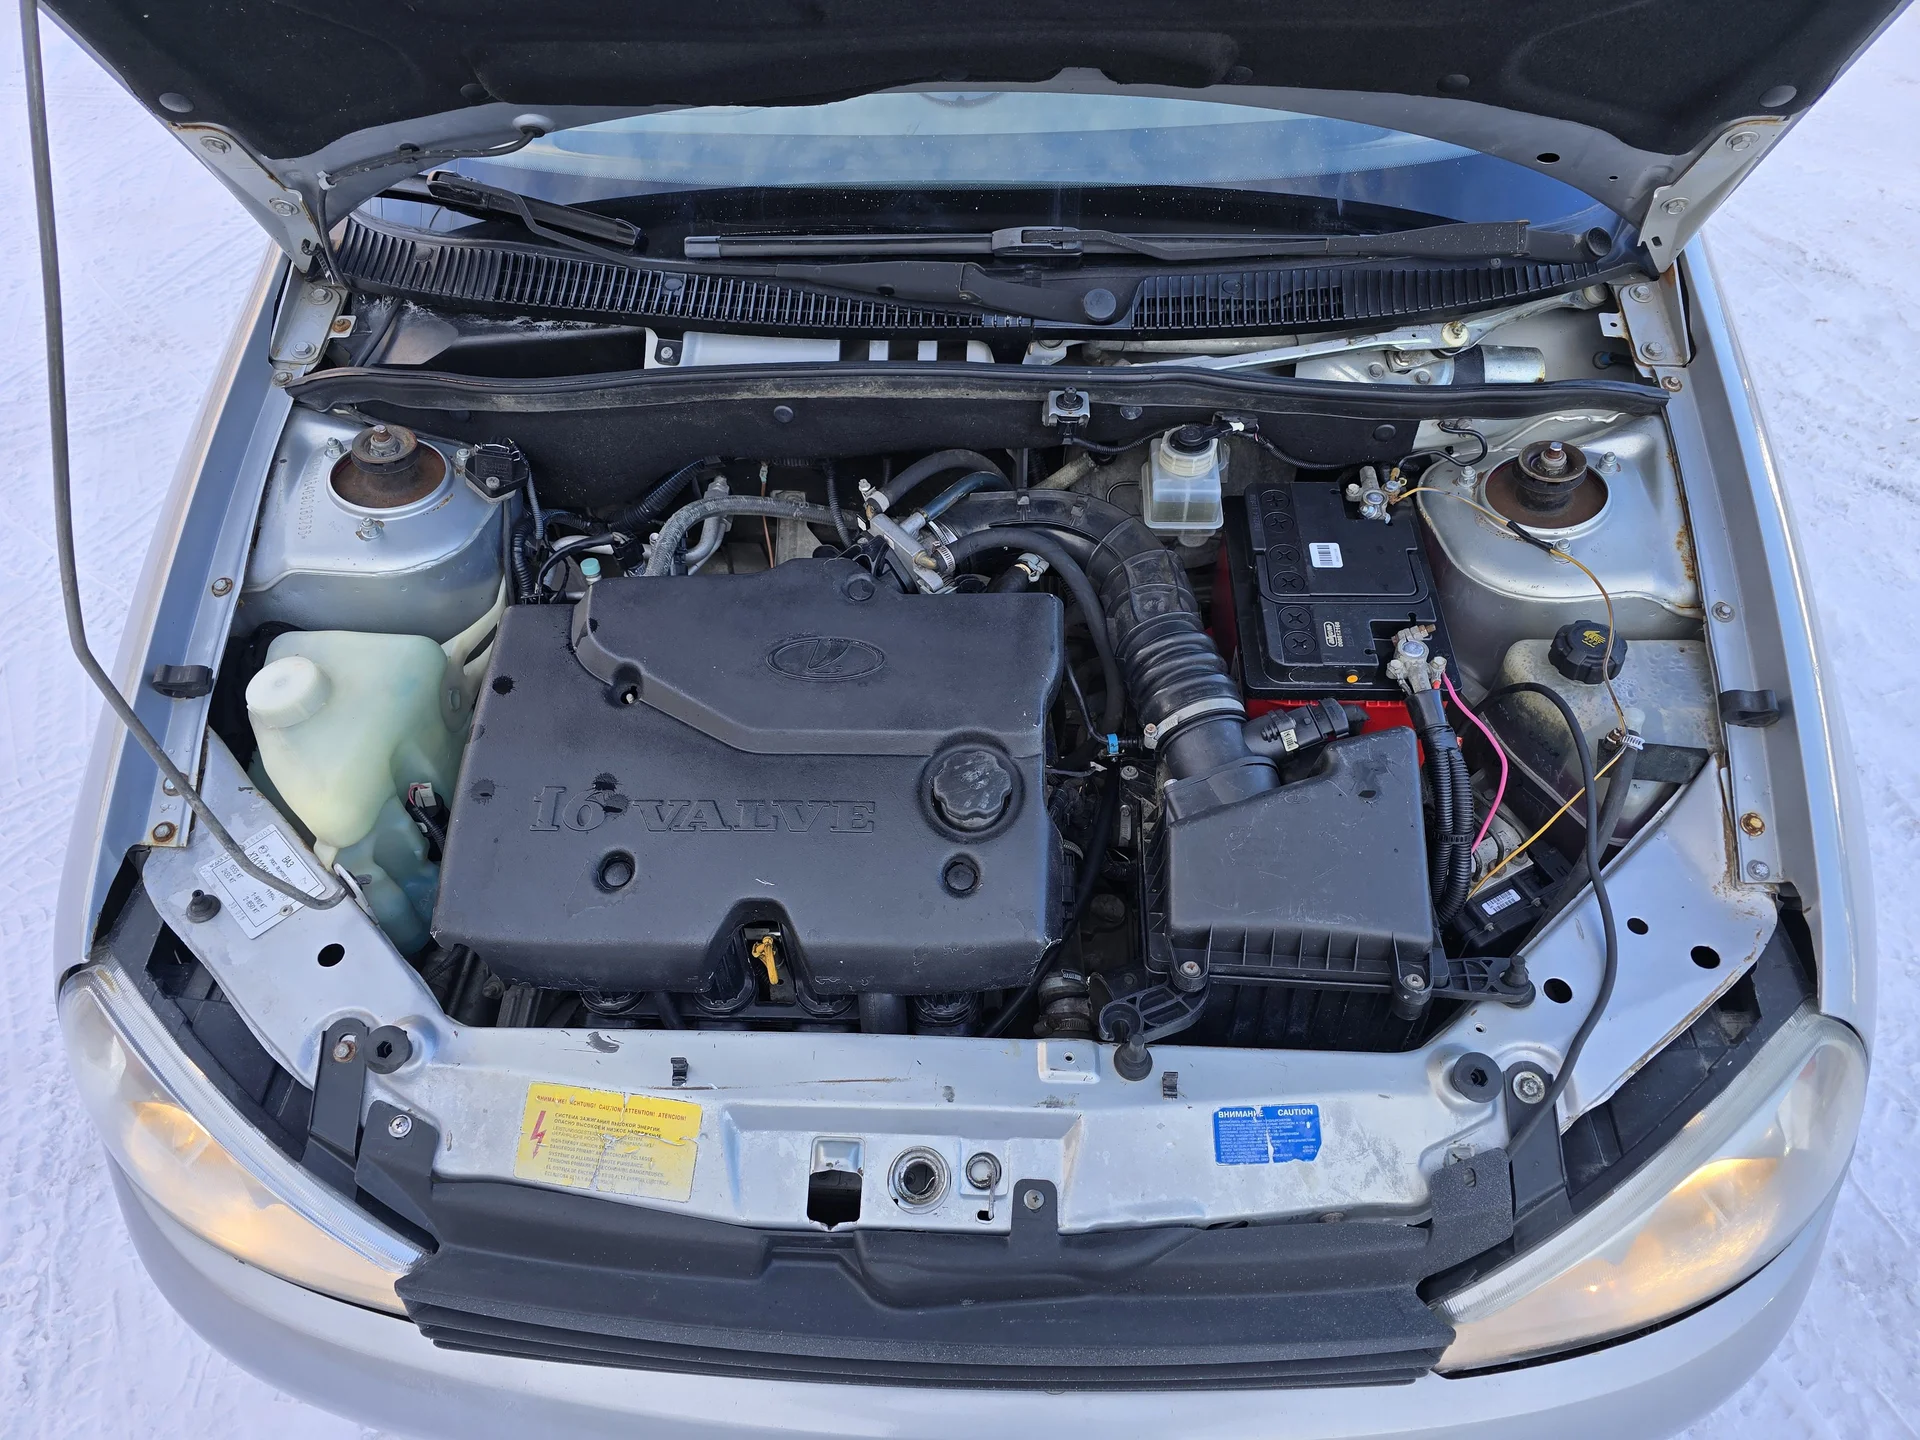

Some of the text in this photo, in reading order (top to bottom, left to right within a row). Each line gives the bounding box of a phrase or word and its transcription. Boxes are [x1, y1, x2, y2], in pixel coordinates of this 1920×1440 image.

[530, 785, 875, 833] 16 VALVE
[1277, 1108, 1314, 1117] CAUTION
